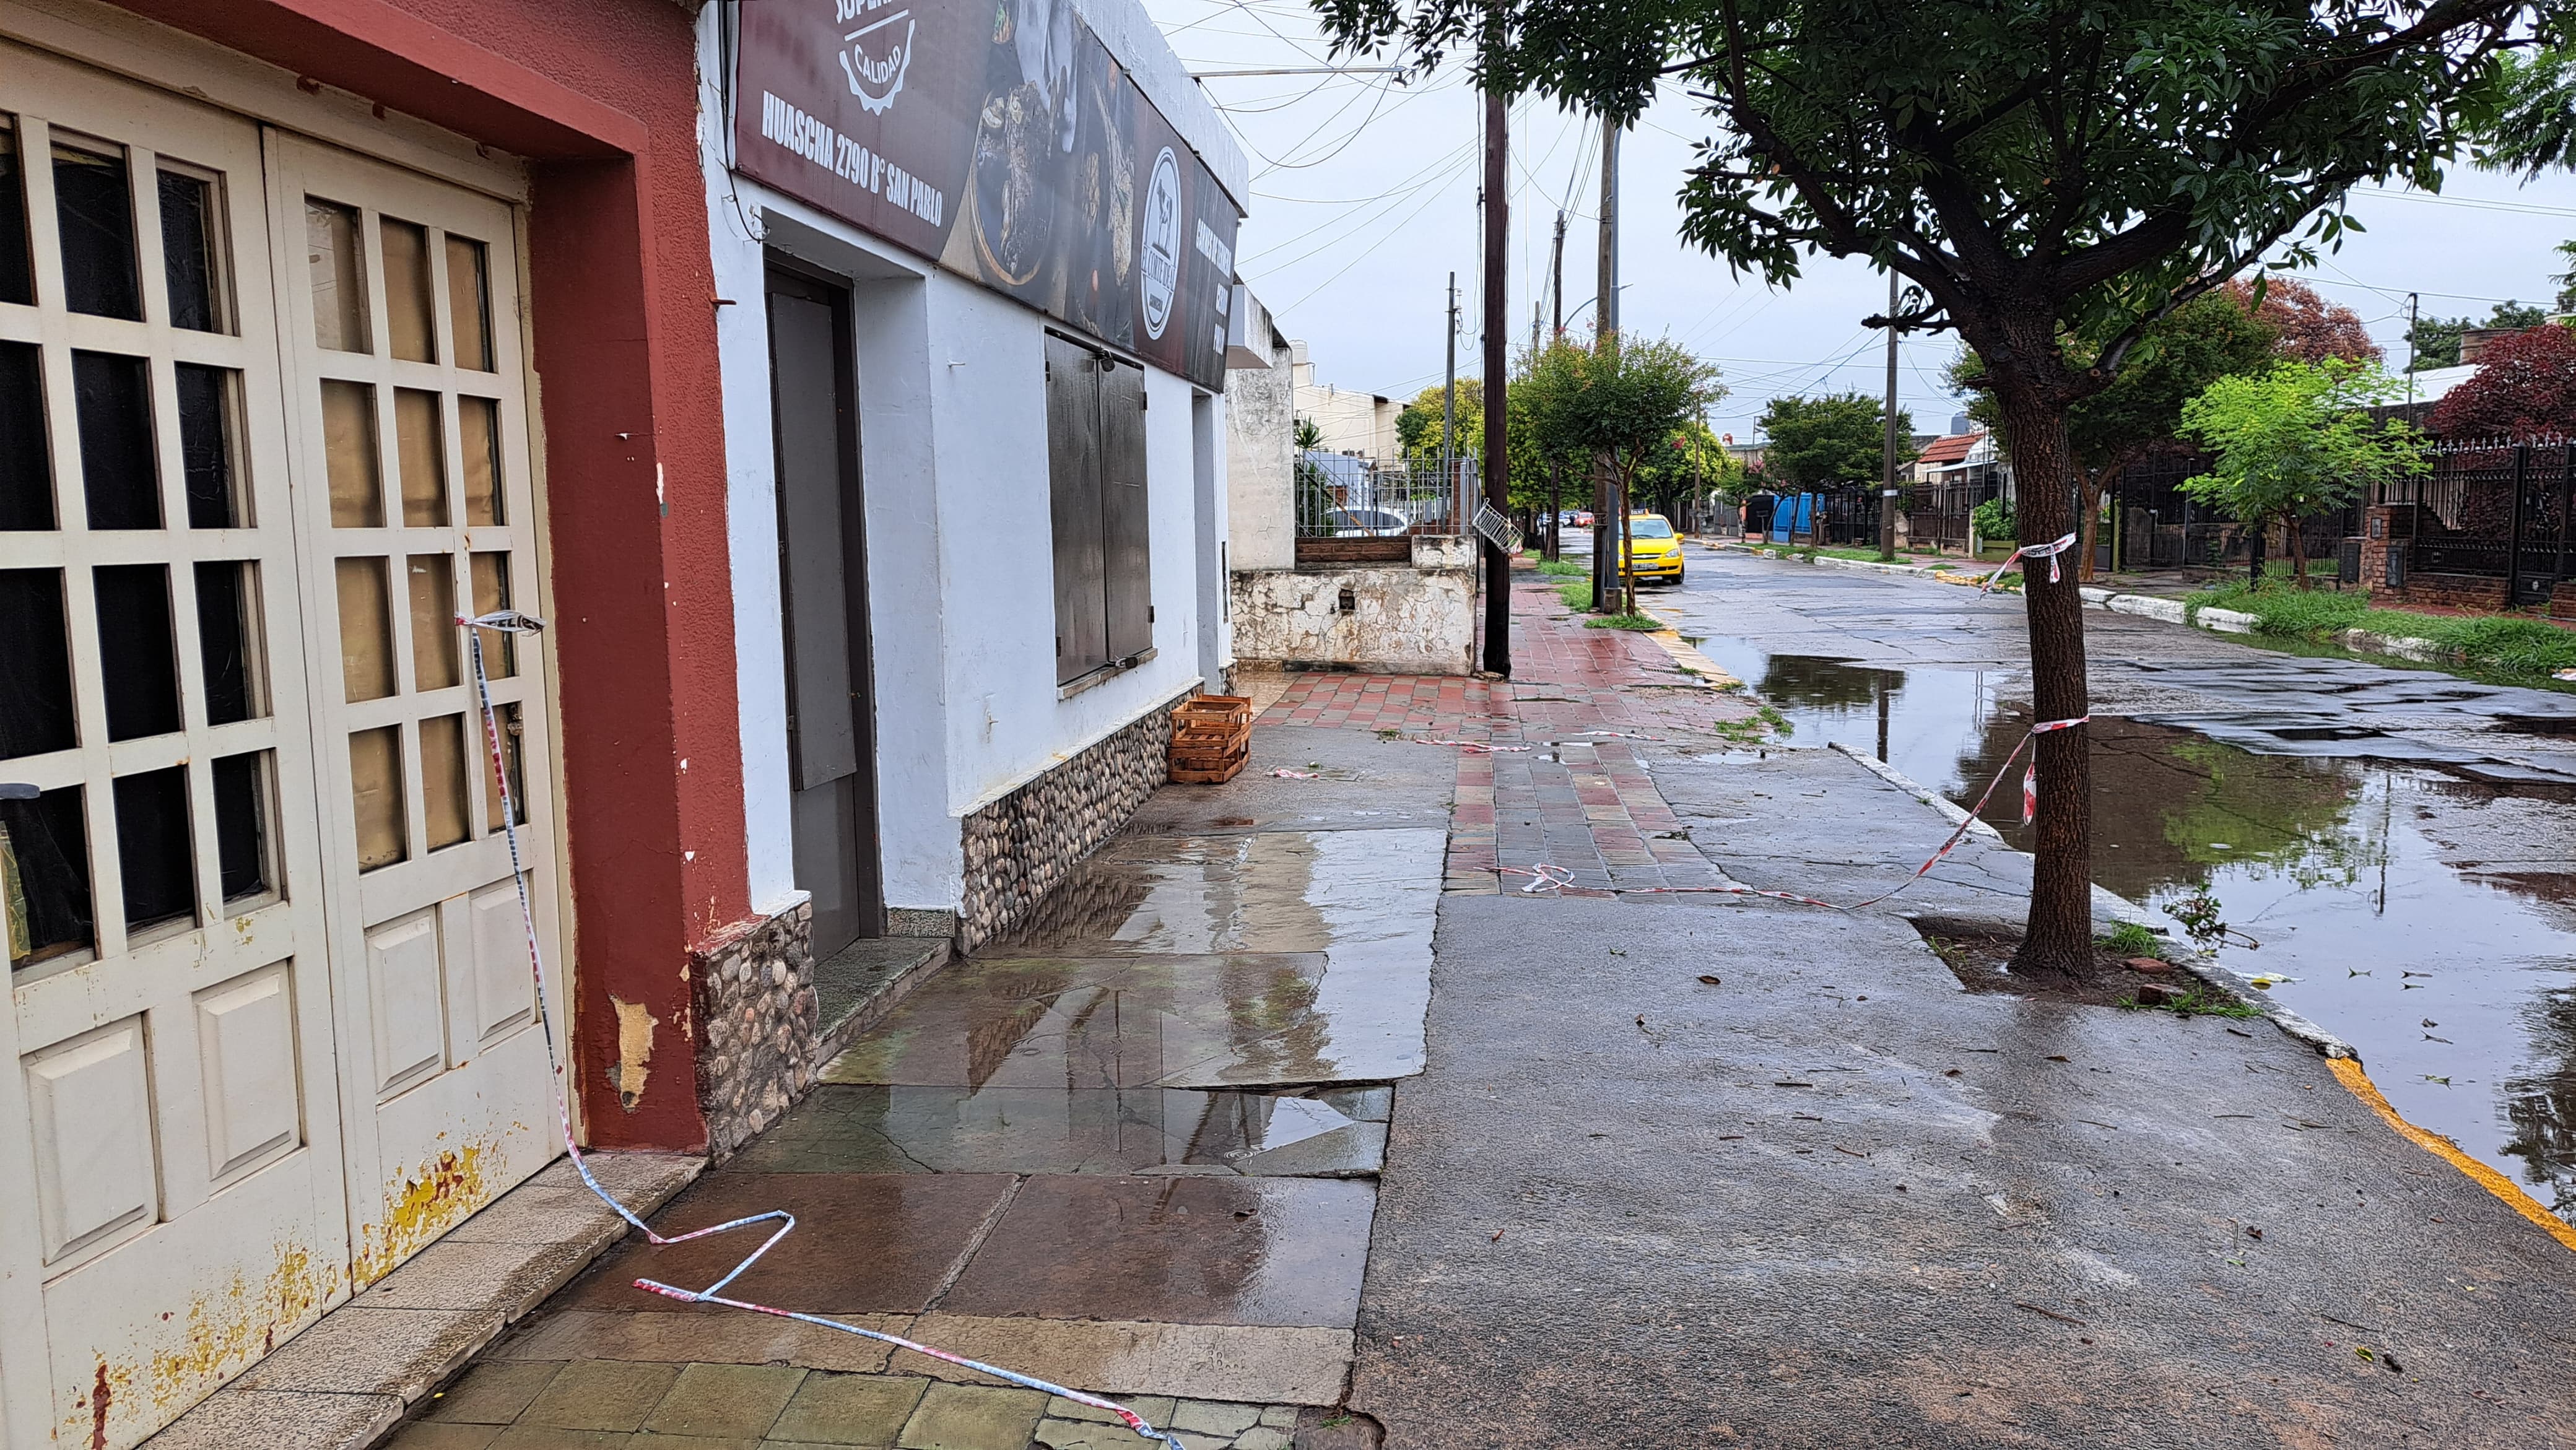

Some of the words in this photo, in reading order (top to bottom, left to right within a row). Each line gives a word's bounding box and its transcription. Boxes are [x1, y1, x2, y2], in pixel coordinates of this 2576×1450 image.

[836, 0, 892, 24] SUP
[855, 43, 900, 84] CALIDAD
[762, 90, 833, 171] HUASCHA
[836, 133, 869, 188] 2790
[886, 163, 910, 210] SAN
[910, 176, 942, 227] PABLO
